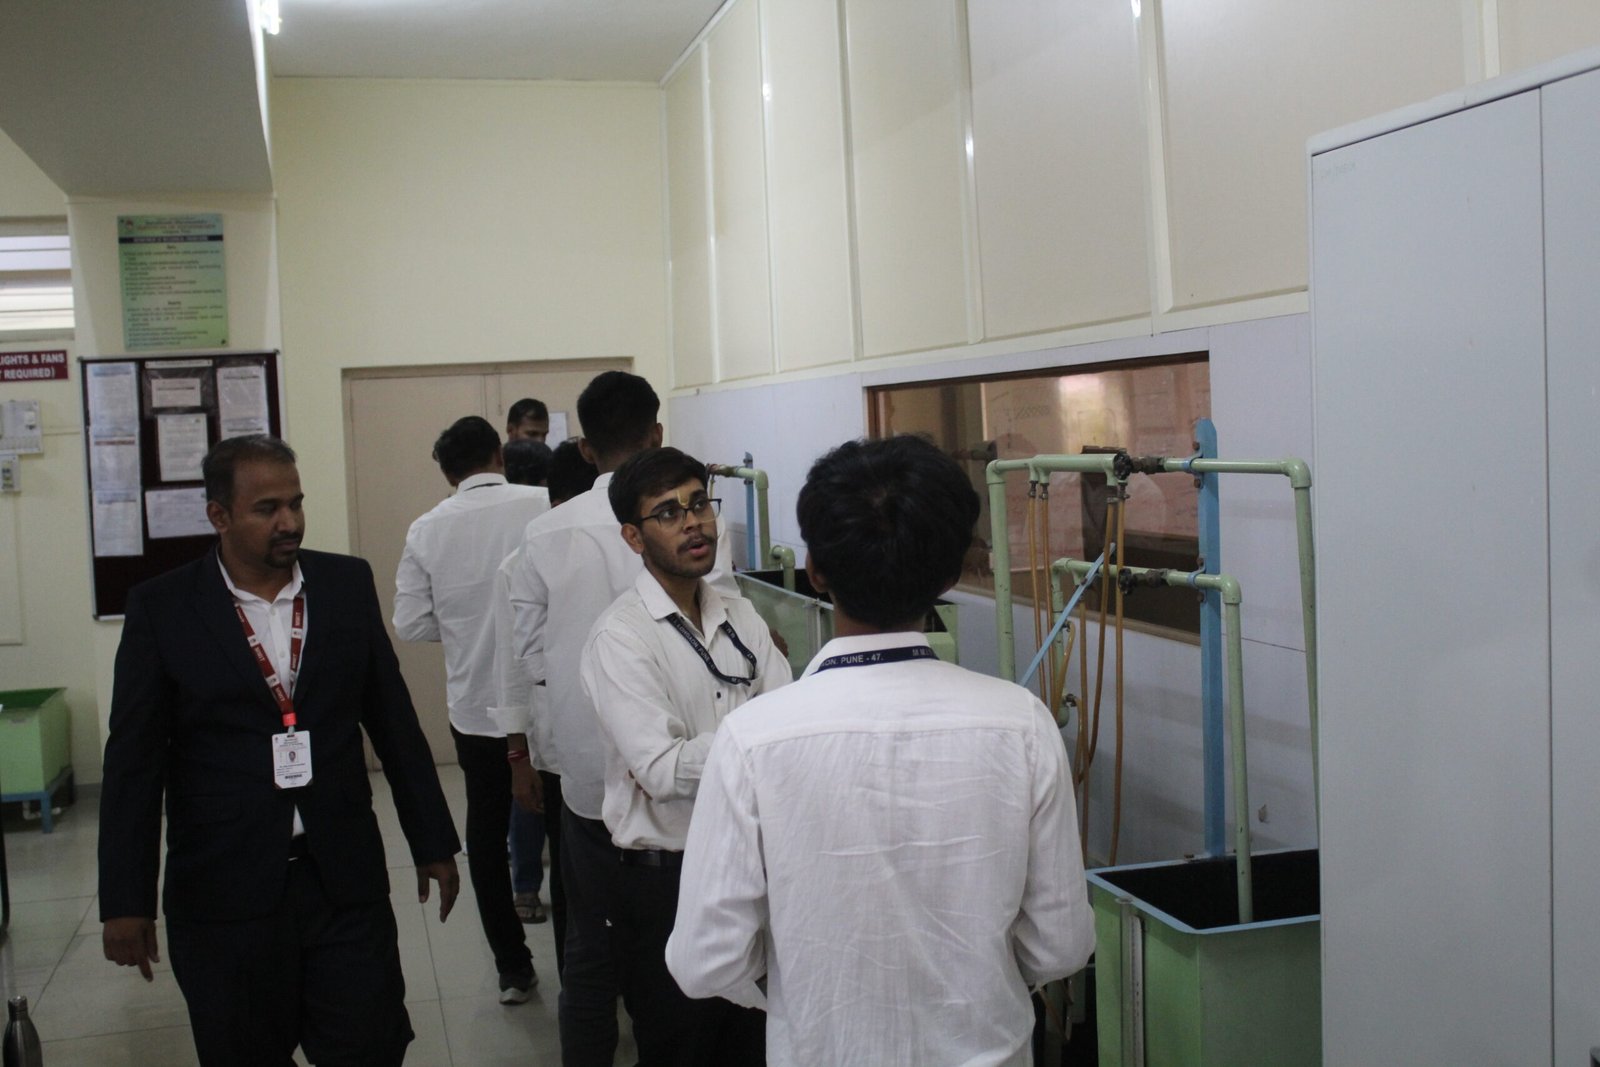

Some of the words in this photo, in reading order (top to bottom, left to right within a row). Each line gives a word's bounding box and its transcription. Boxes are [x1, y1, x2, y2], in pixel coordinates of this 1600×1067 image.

[0, 355, 29, 365] IGHTS
[31, 354, 39, 364] &
[41, 353, 64, 363] FANS
[4, 367, 55, 379] REQUIRED)
[840, 654, 864, 664] PUNE
[871, 653, 884, 661] 47.
